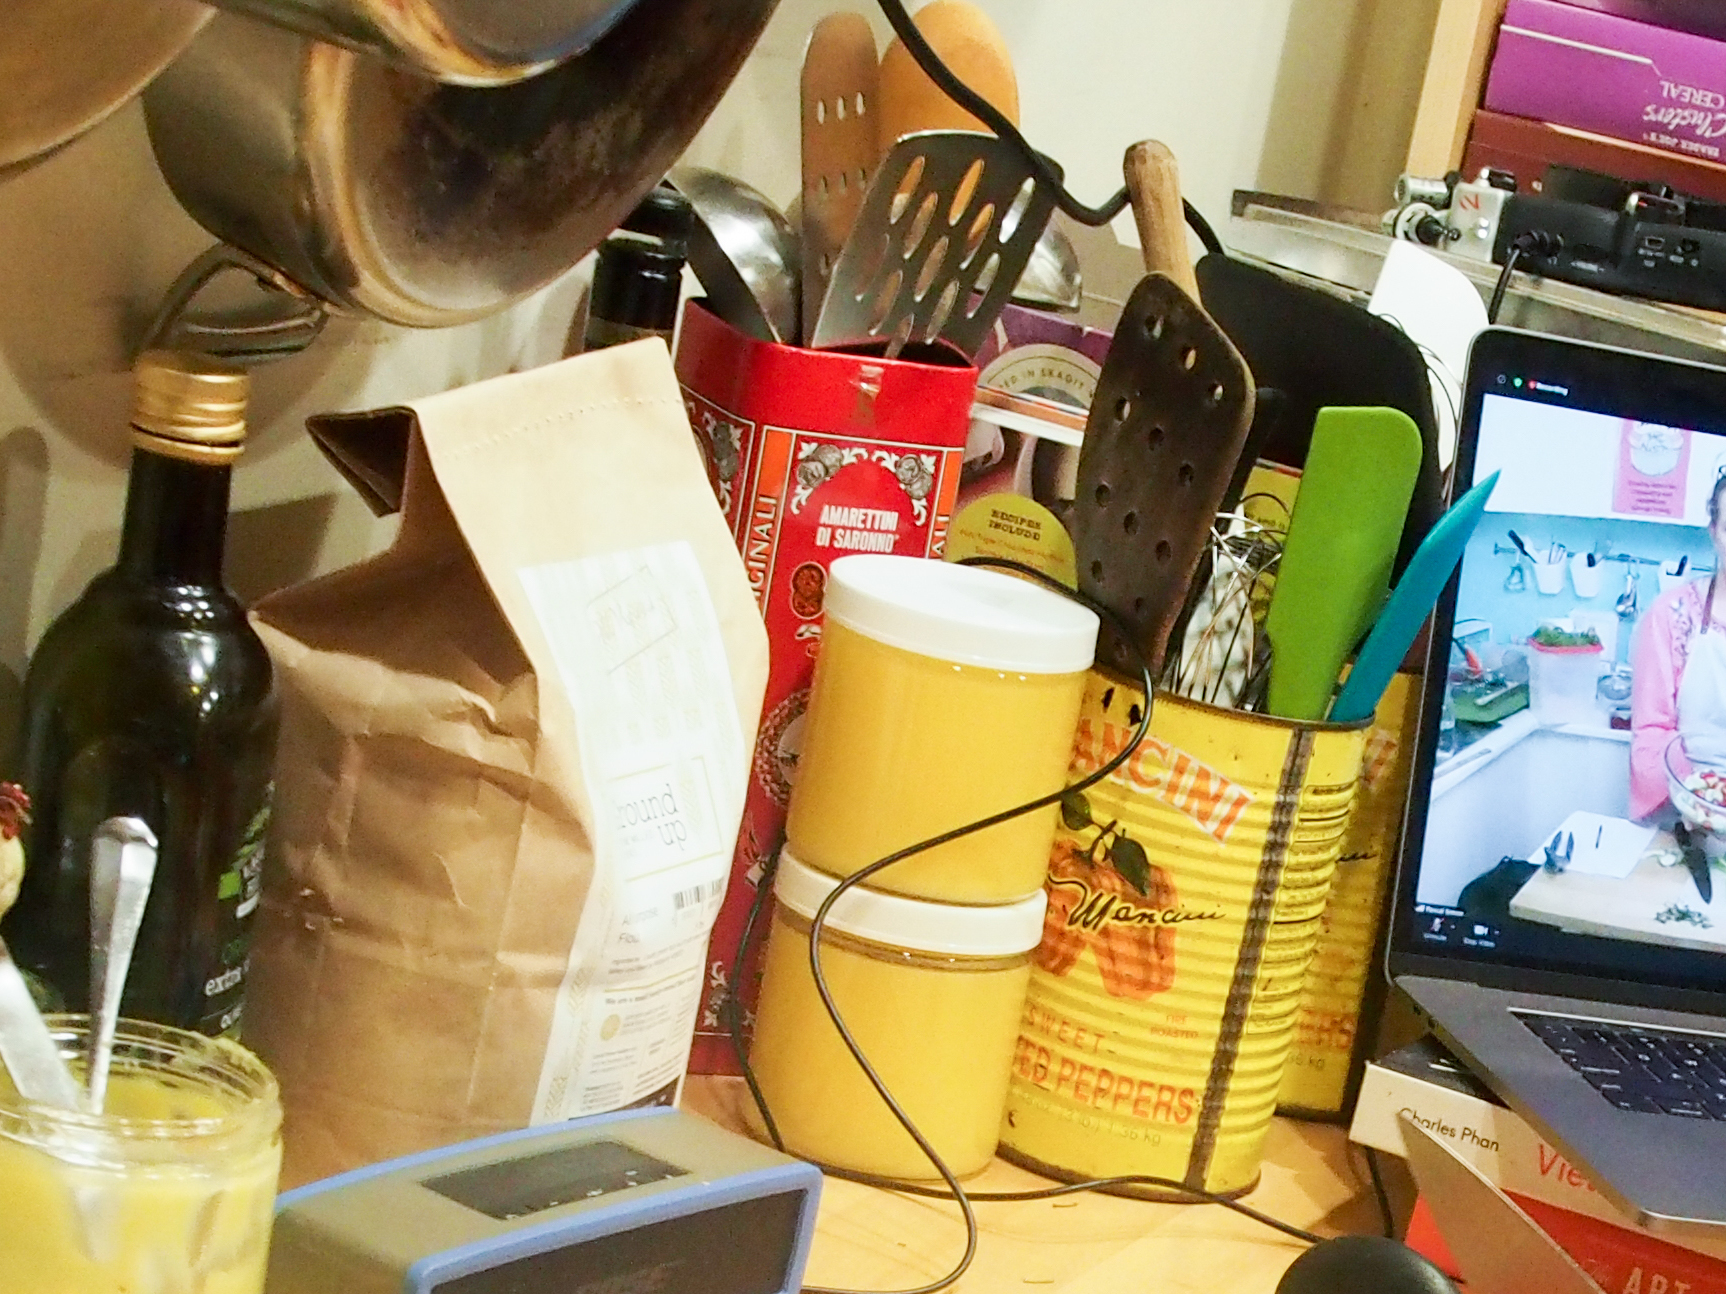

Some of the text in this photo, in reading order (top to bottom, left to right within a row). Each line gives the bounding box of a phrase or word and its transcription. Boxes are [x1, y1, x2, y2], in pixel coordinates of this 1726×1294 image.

[1660, 80, 1725, 109] CEREAL
[820, 504, 900, 532] AMARETTINI
[815, 526, 832, 548] DI
[1067, 717, 1255, 847] ANCINI
[657, 819, 688, 852] up
[1028, 1003, 1105, 1053] SWEET
[1056, 1057, 1195, 1125] PEPPERS
[1461, 1126, 1500, 1153] Phan
